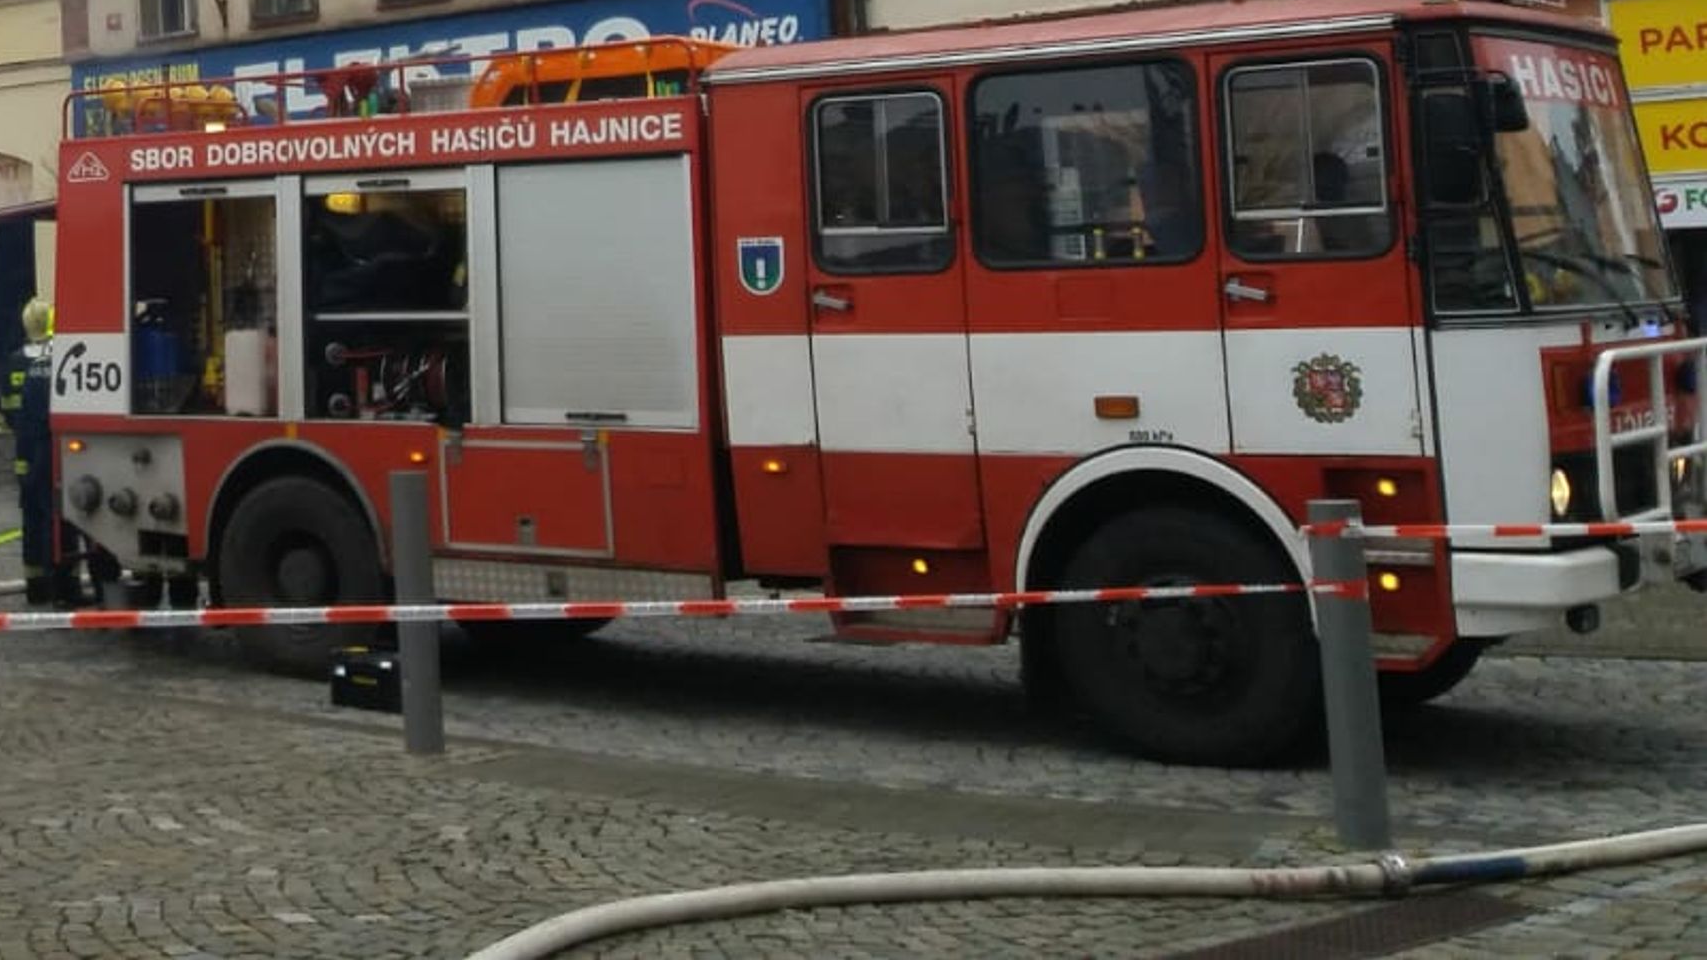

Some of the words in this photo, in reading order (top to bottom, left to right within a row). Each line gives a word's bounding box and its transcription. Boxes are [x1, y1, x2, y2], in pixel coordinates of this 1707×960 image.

[690, 14, 799, 48] PLANEO
[1510, 54, 1620, 108] HASIČI
[130, 146, 195, 171] SBOR
[207, 126, 416, 167] DOBROVOLNÝCH
[431, 114, 537, 154] HASIČŮ
[551, 112, 683, 147] HAJNICE
[71, 361, 122, 392] 150
